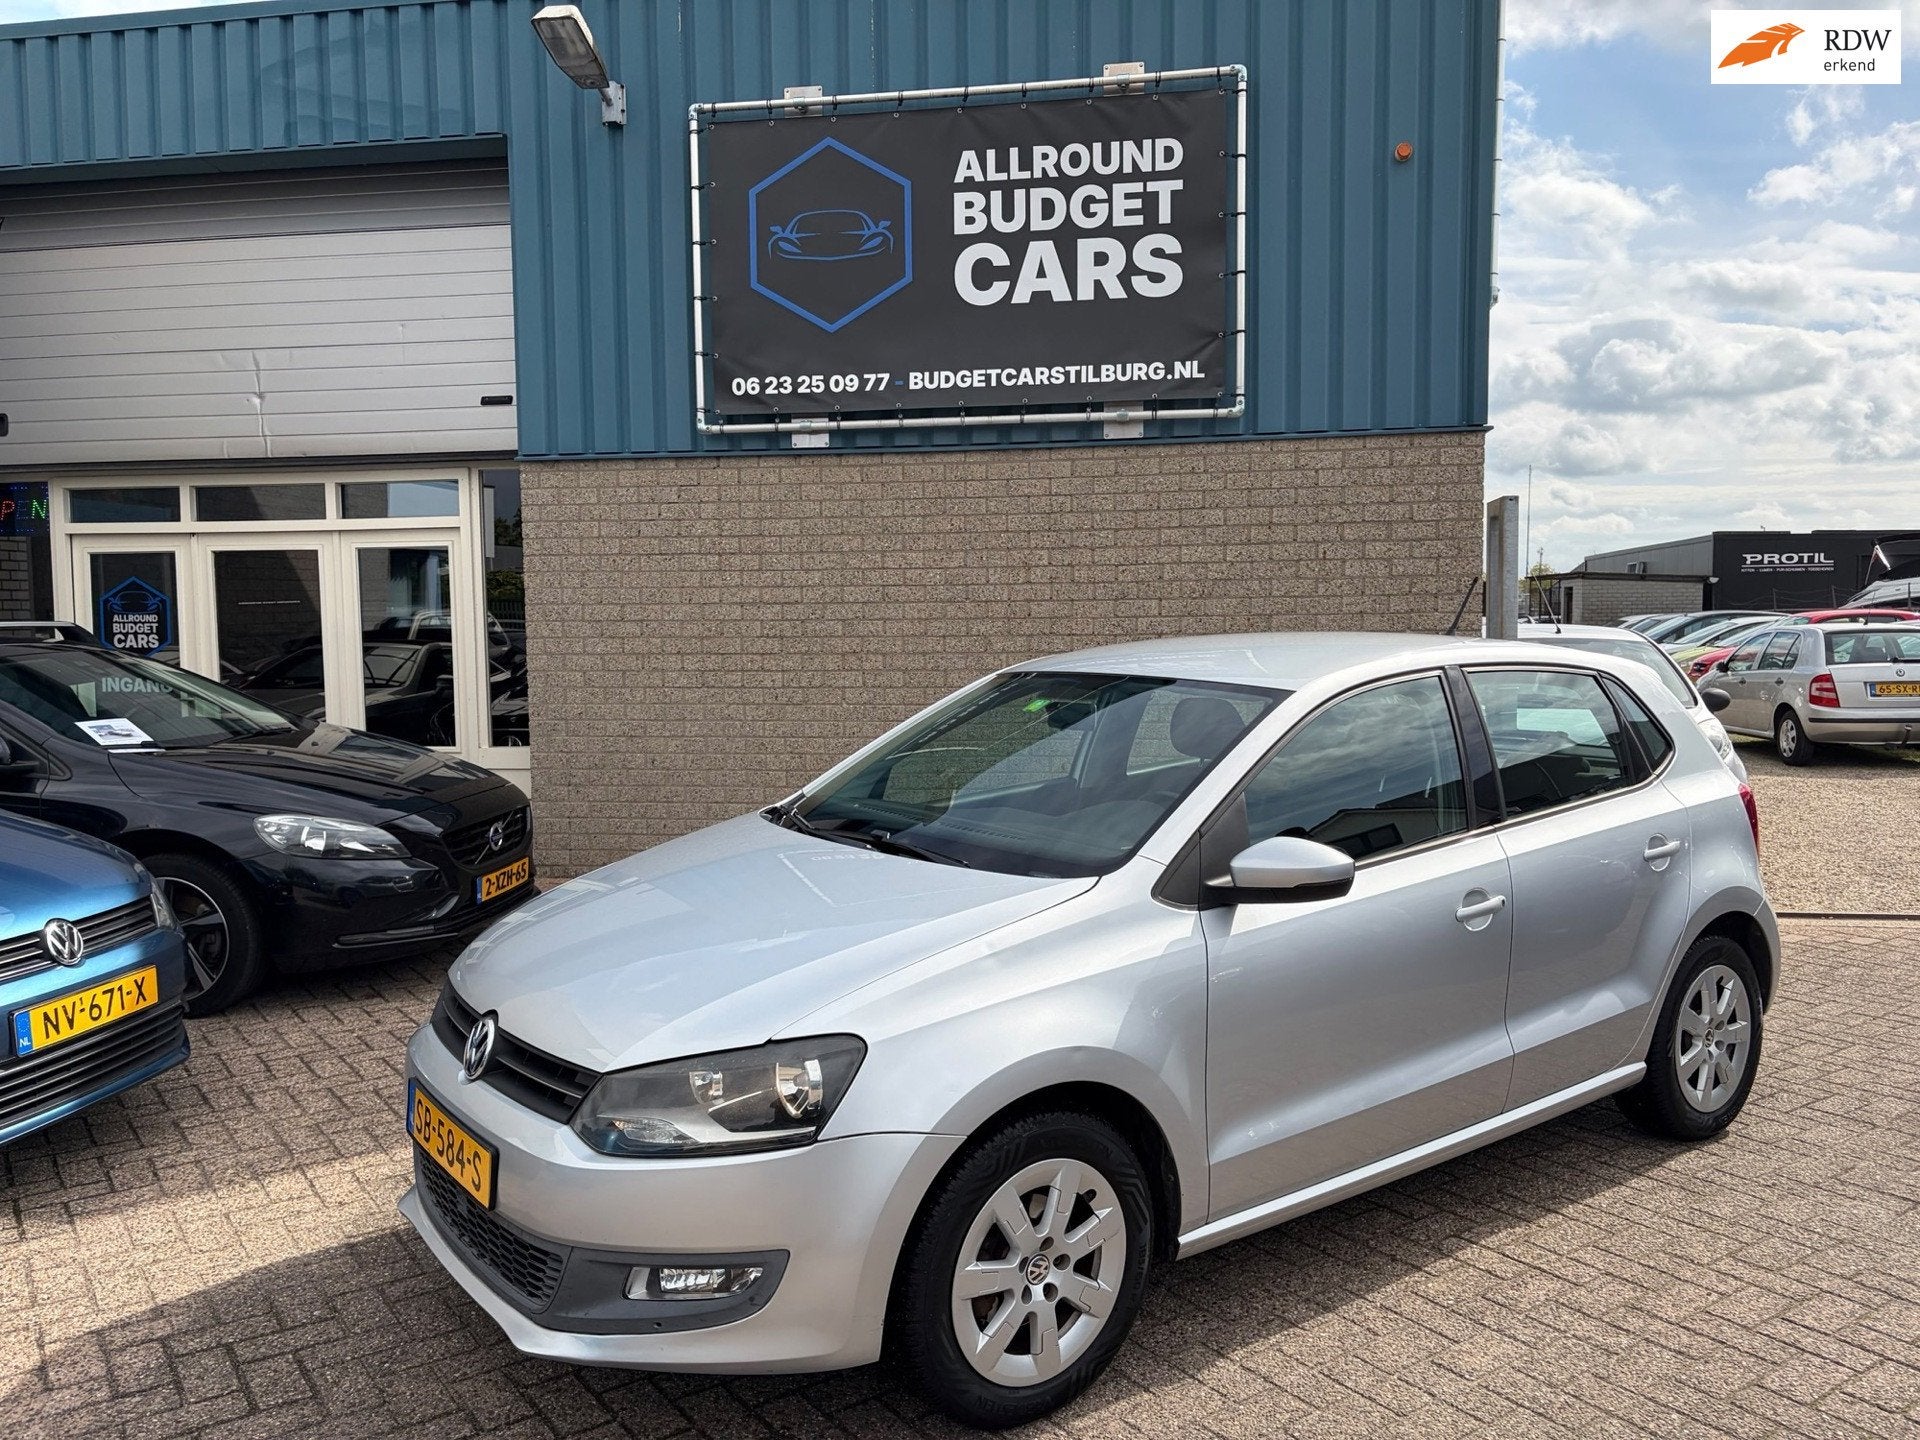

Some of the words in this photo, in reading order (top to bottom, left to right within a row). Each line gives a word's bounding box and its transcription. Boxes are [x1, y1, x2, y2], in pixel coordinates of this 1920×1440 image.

[953, 137, 1184, 183] ALLROUND
[953, 179, 1184, 235] BUDGET
[954, 233, 1184, 306] CARS
[731, 377, 760, 396] 06
[764, 376, 793, 395] 23
[797, 375, 825, 393] 25
[829, 373, 859, 392] 09
[863, 373, 890, 392] 77
[909, 360, 1205, 390] BUDGETCARSTILBURG.NL
[1742, 552, 1834, 565] PROTIL
[112, 614, 159, 622] ALLROUND
[112, 623, 159, 633] BUDGET
[113, 633, 160, 648] CARS
[1878, 684, 1920, 694] 65-SX-R
[42, 976, 147, 1040] NV-671-X
[19, 1037, 31, 1048] NL
[415, 1098, 482, 1192] SB-584-S
